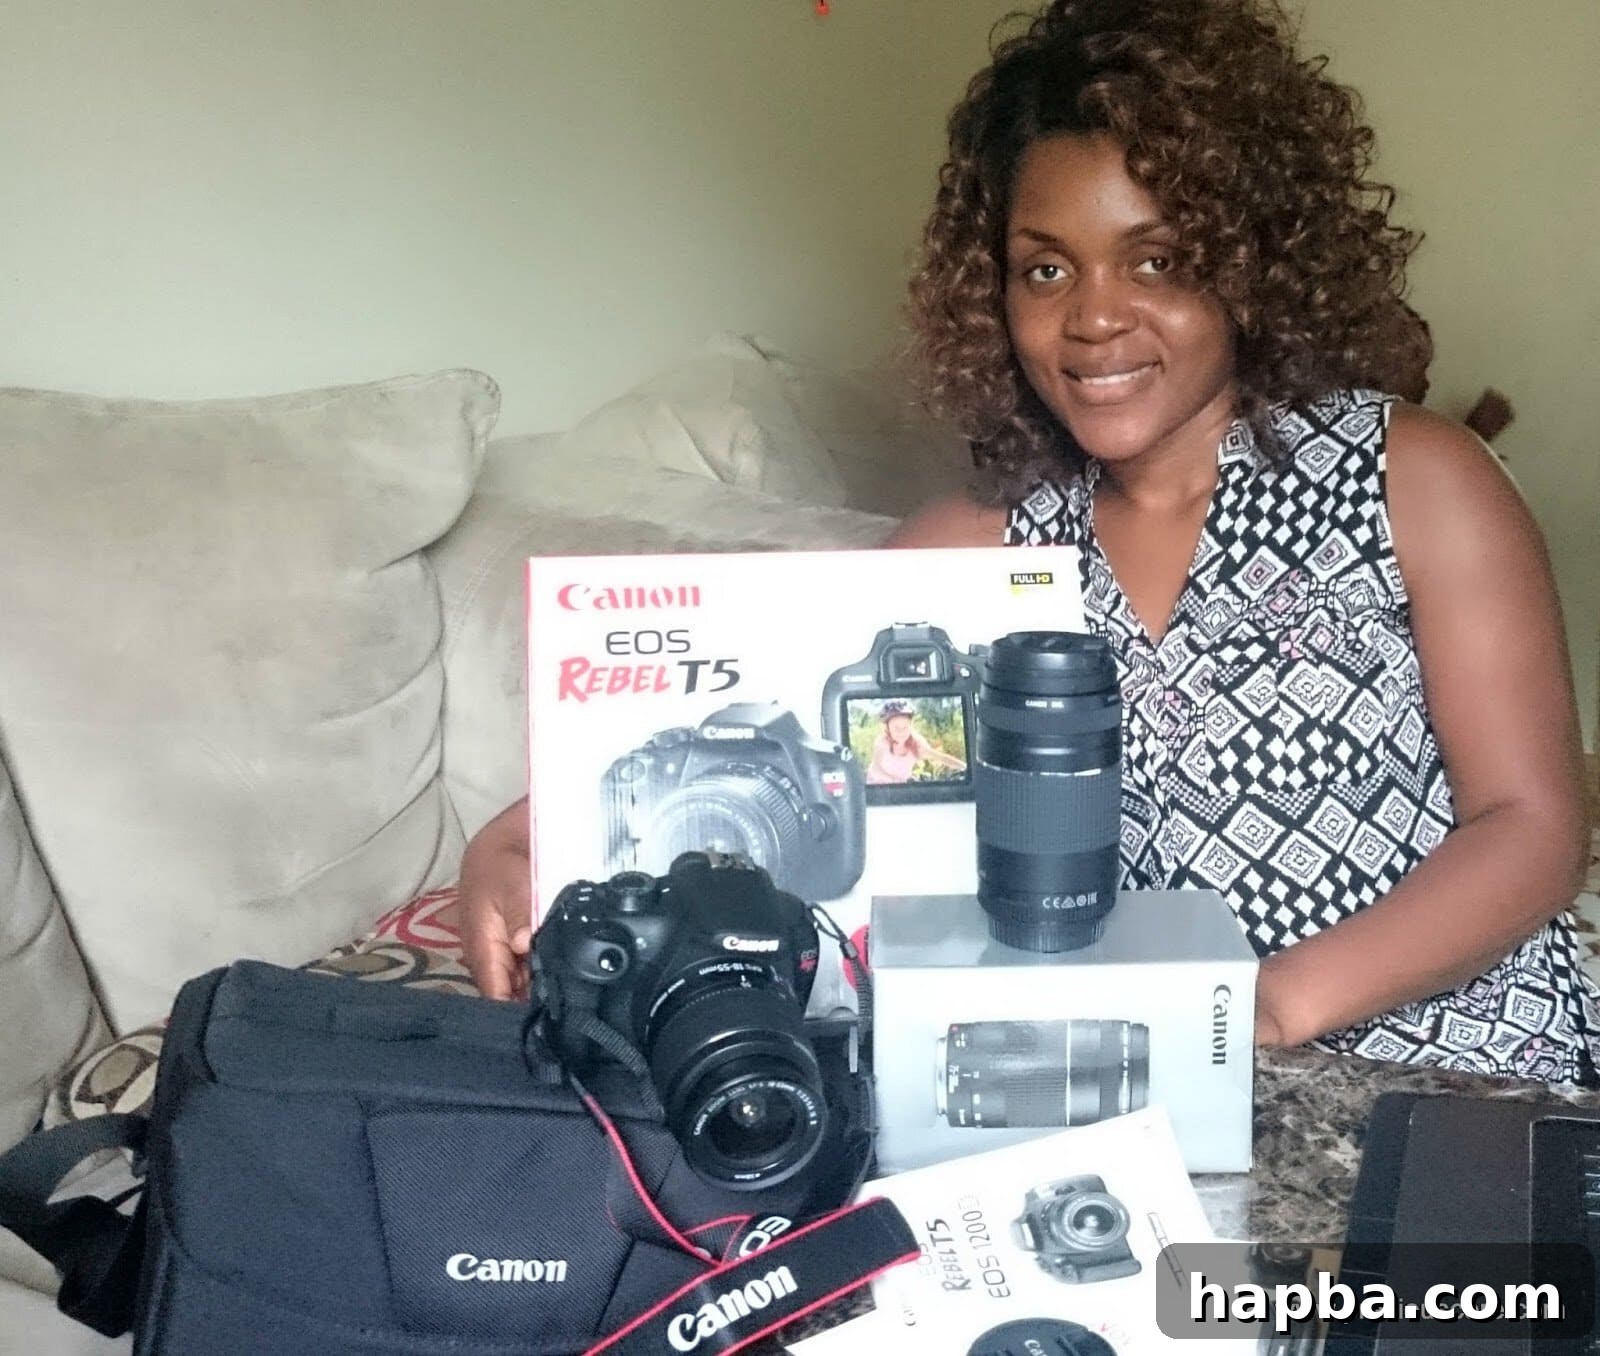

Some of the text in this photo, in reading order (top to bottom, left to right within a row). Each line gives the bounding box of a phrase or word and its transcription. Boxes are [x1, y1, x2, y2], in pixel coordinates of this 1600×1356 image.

[1013, 574, 1035, 584] FULL
[557, 583, 701, 611] Canon
[606, 629, 691, 655] EOS
[677, 658, 741, 695] T5
[702, 726, 756, 740] Canon
[722, 935, 780, 952] Canon
[1212, 983, 1232, 1066] Canon
[739, 1216, 792, 1259] EO
[446, 1253, 568, 1282] Canon
[977, 1255, 1011, 1298] EOS
[667, 1265, 798, 1352] Canon
